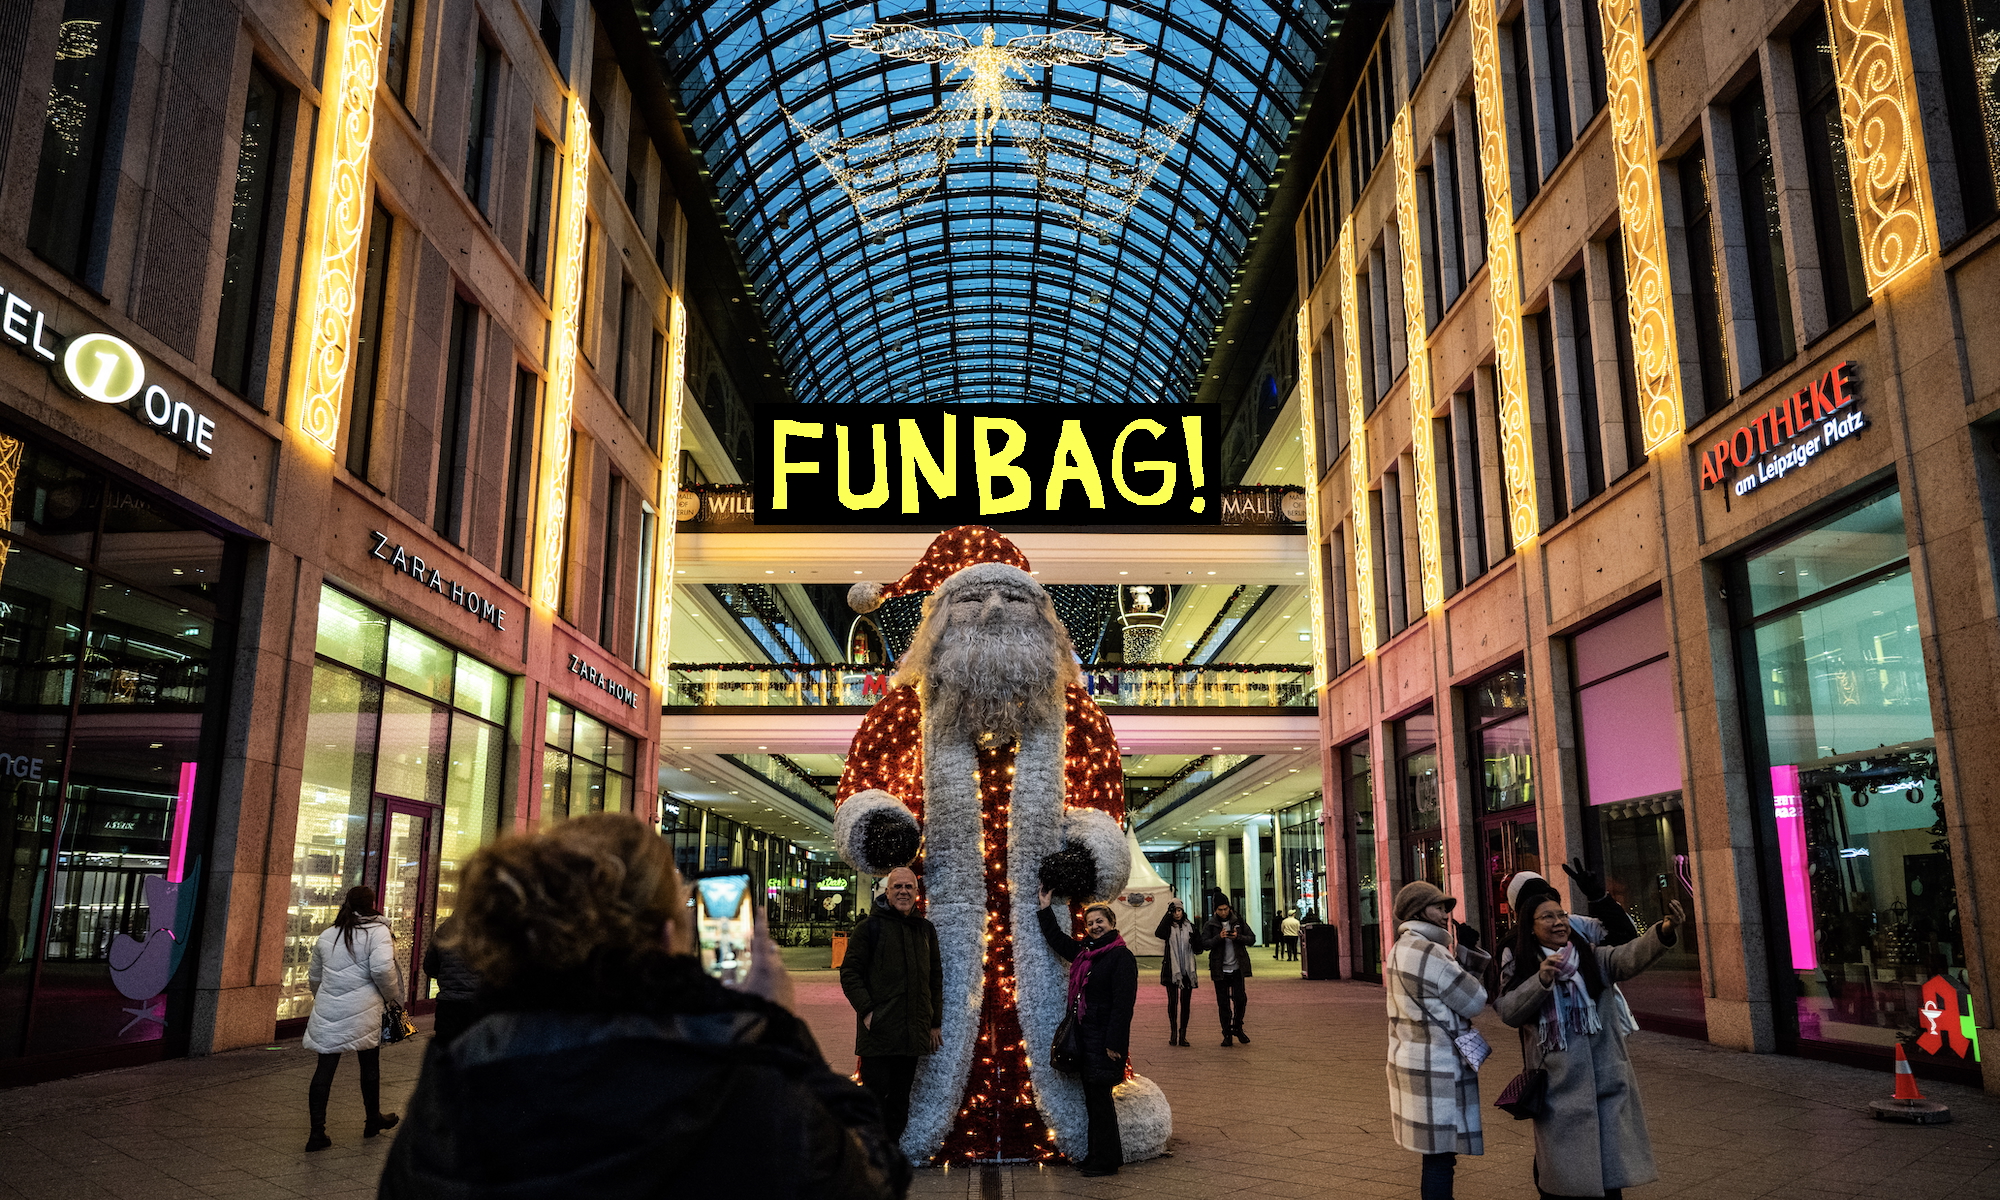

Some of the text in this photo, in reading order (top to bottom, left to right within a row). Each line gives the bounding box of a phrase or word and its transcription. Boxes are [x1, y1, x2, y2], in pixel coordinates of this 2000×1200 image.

[0, 286, 55, 361] EL
[1700, 361, 1855, 490] APOTHEKE
[1735, 411, 1864, 496] am Leipziger Platz
[1222, 497, 1274, 514] MALL
[373, 530, 507, 632] ZARA HOME
[570, 654, 638, 710] ZARA HOME
